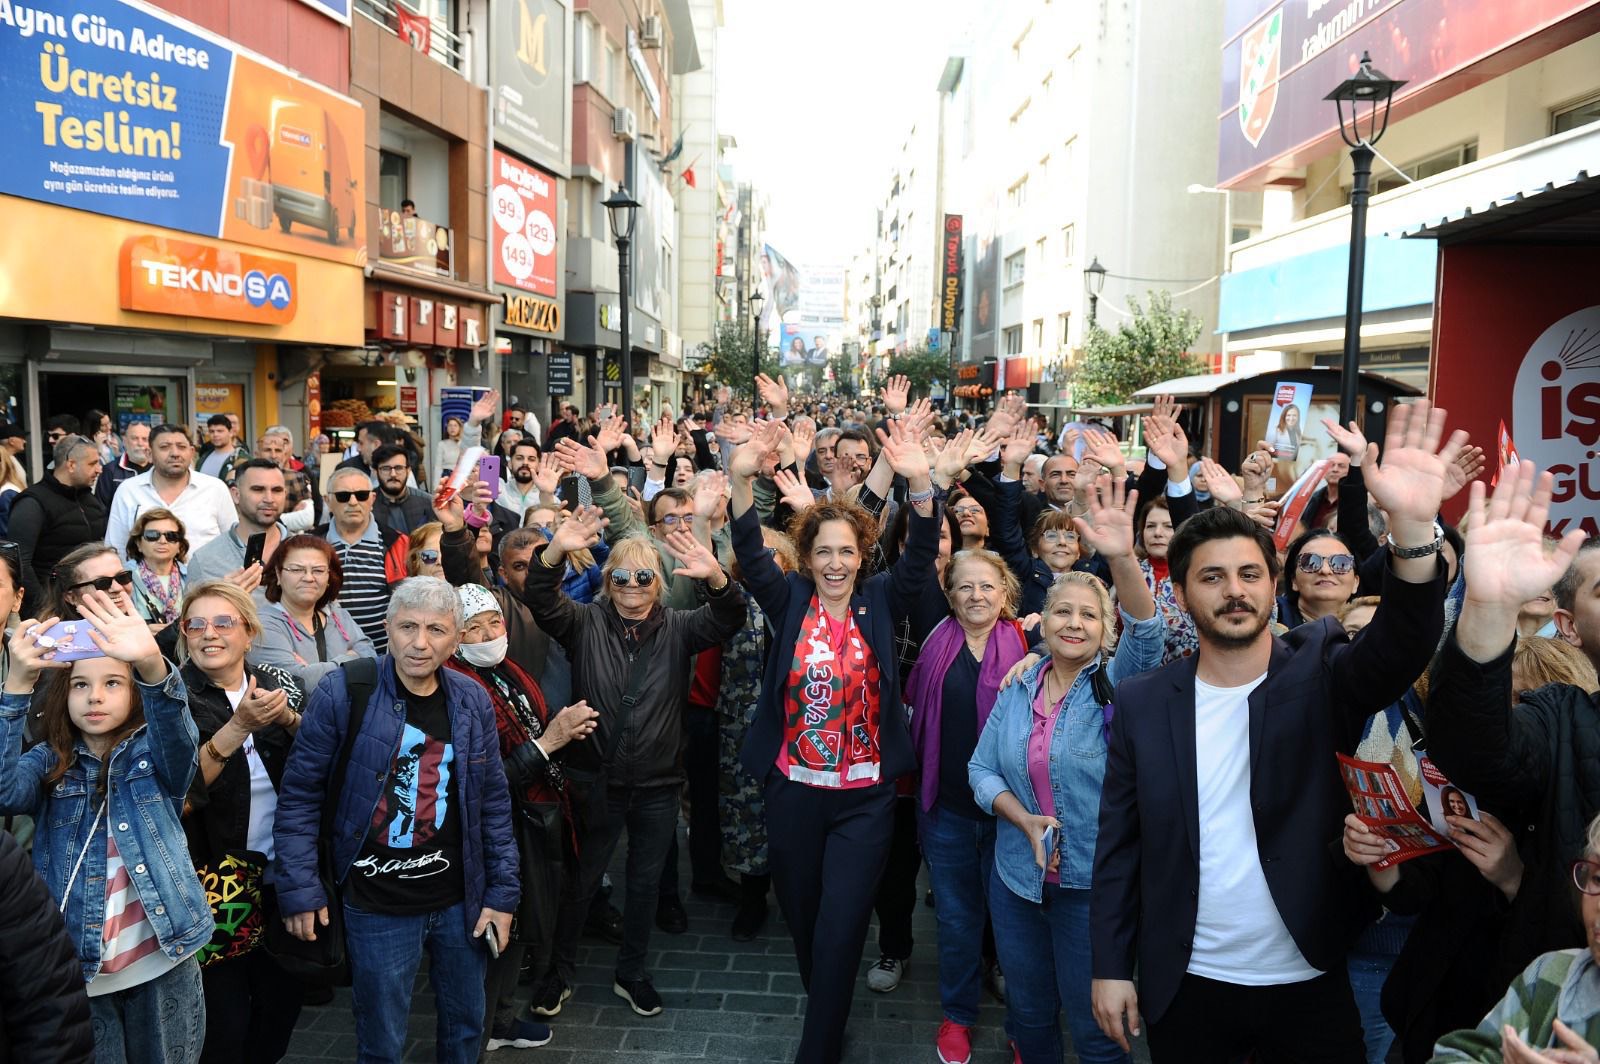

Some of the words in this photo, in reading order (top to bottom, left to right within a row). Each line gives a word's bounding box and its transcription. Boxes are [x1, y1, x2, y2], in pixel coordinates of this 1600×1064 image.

[0, 0, 68, 38] Aynı
[71, 13, 126, 51] Gün
[129, 27, 210, 70] Adrese
[517, 0, 547, 76] M
[40, 41, 178, 112] Ücretsiz
[35, 101, 182, 160] Teslim!
[43, 180, 65, 192] aynı
[66, 180, 83, 193] gün
[84, 180, 119, 194] ücretsiz
[119, 183, 145, 196] teslim
[145, 187, 180, 199] ediyoruz.
[50, 161, 116, 178] Mağazamızdan
[117, 168, 151, 182] aldığınız
[152, 170, 175, 182] ürünü
[498, 198, 516, 219] 99
[529, 223, 549, 243] 129
[505, 246, 527, 267] 149
[947, 235, 960, 274] Tavuk
[141, 260, 291, 303] TEKNOSA
[506, 292, 561, 333] MEZZO
[810, 734, 831, 760] K.S.K.
